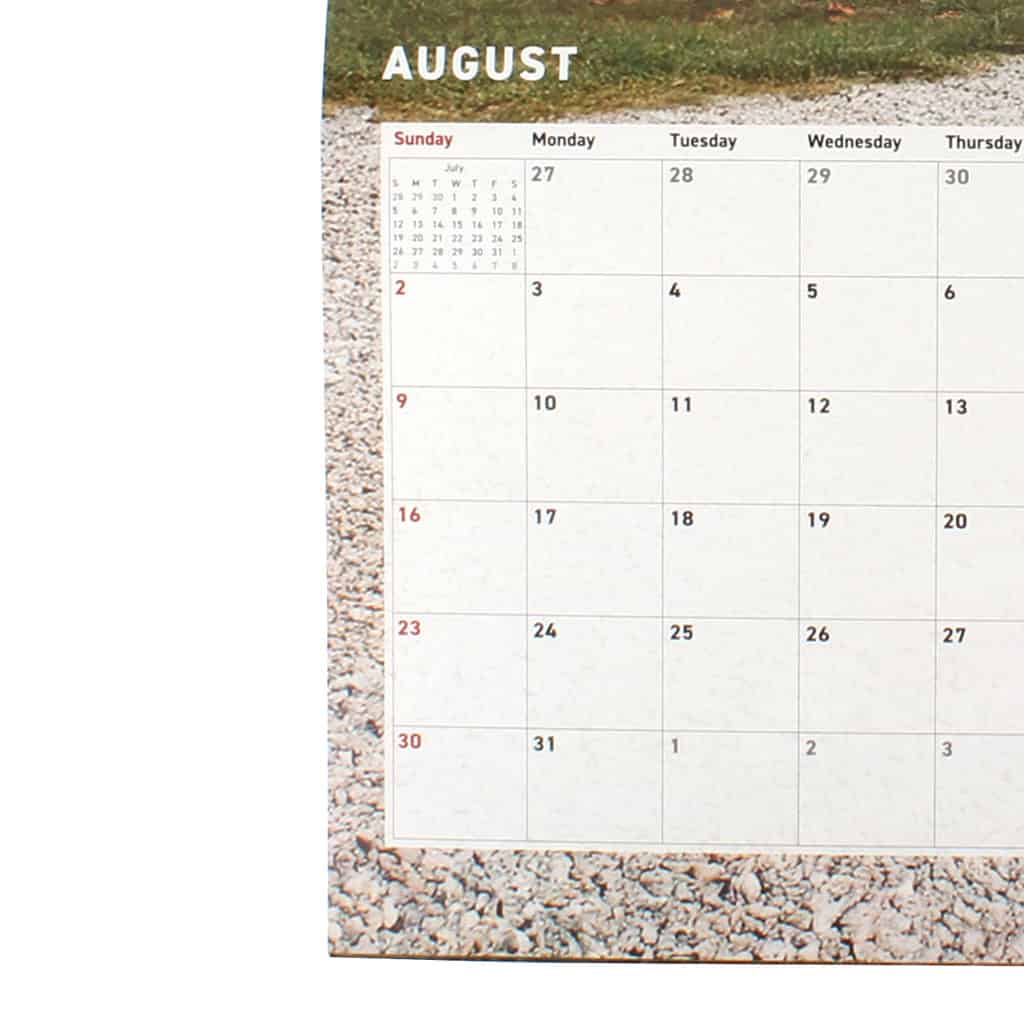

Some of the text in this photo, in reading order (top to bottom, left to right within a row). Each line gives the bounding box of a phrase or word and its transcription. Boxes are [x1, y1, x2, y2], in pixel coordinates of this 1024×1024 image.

[382, 45, 578, 81] AUGUST
[394, 130, 454, 150] Sunday
[532, 131, 596, 150] Monday
[669, 132, 737, 152] Tuesday
[807, 133, 902, 153] Wednesday
[945, 134, 1023, 153] Thursday
[443, 163, 464, 173] July
[531, 165, 555, 182] 27
[669, 166, 694, 183] 28
[807, 167, 831, 184] 29
[945, 168, 970, 185] 30
[395, 279, 406, 296] 2
[531, 280, 543, 297] 3
[668, 281, 681, 298] 4
[807, 282, 818, 299] 5
[943, 284, 956, 301] 6
[396, 393, 408, 409] 9
[534, 394, 557, 411] 10
[671, 396, 691, 413] 11
[808, 397, 830, 414] 12
[945, 398, 968, 415] 13
[399, 506, 422, 523] 16
[534, 508, 557, 525] 17
[671, 510, 694, 527] 18
[807, 511, 831, 529] 19
[943, 512, 968, 530] 20
[397, 619, 421, 636] 23
[533, 621, 558, 639] 24
[670, 623, 694, 641] 25
[806, 625, 830, 643] 26
[942, 627, 966, 644] 27
[398, 732, 422, 750] 30
[533, 735, 555, 753] 31
[671, 738, 678, 754] 1
[806, 739, 817, 756] 2
[942, 741, 953, 757] 3
